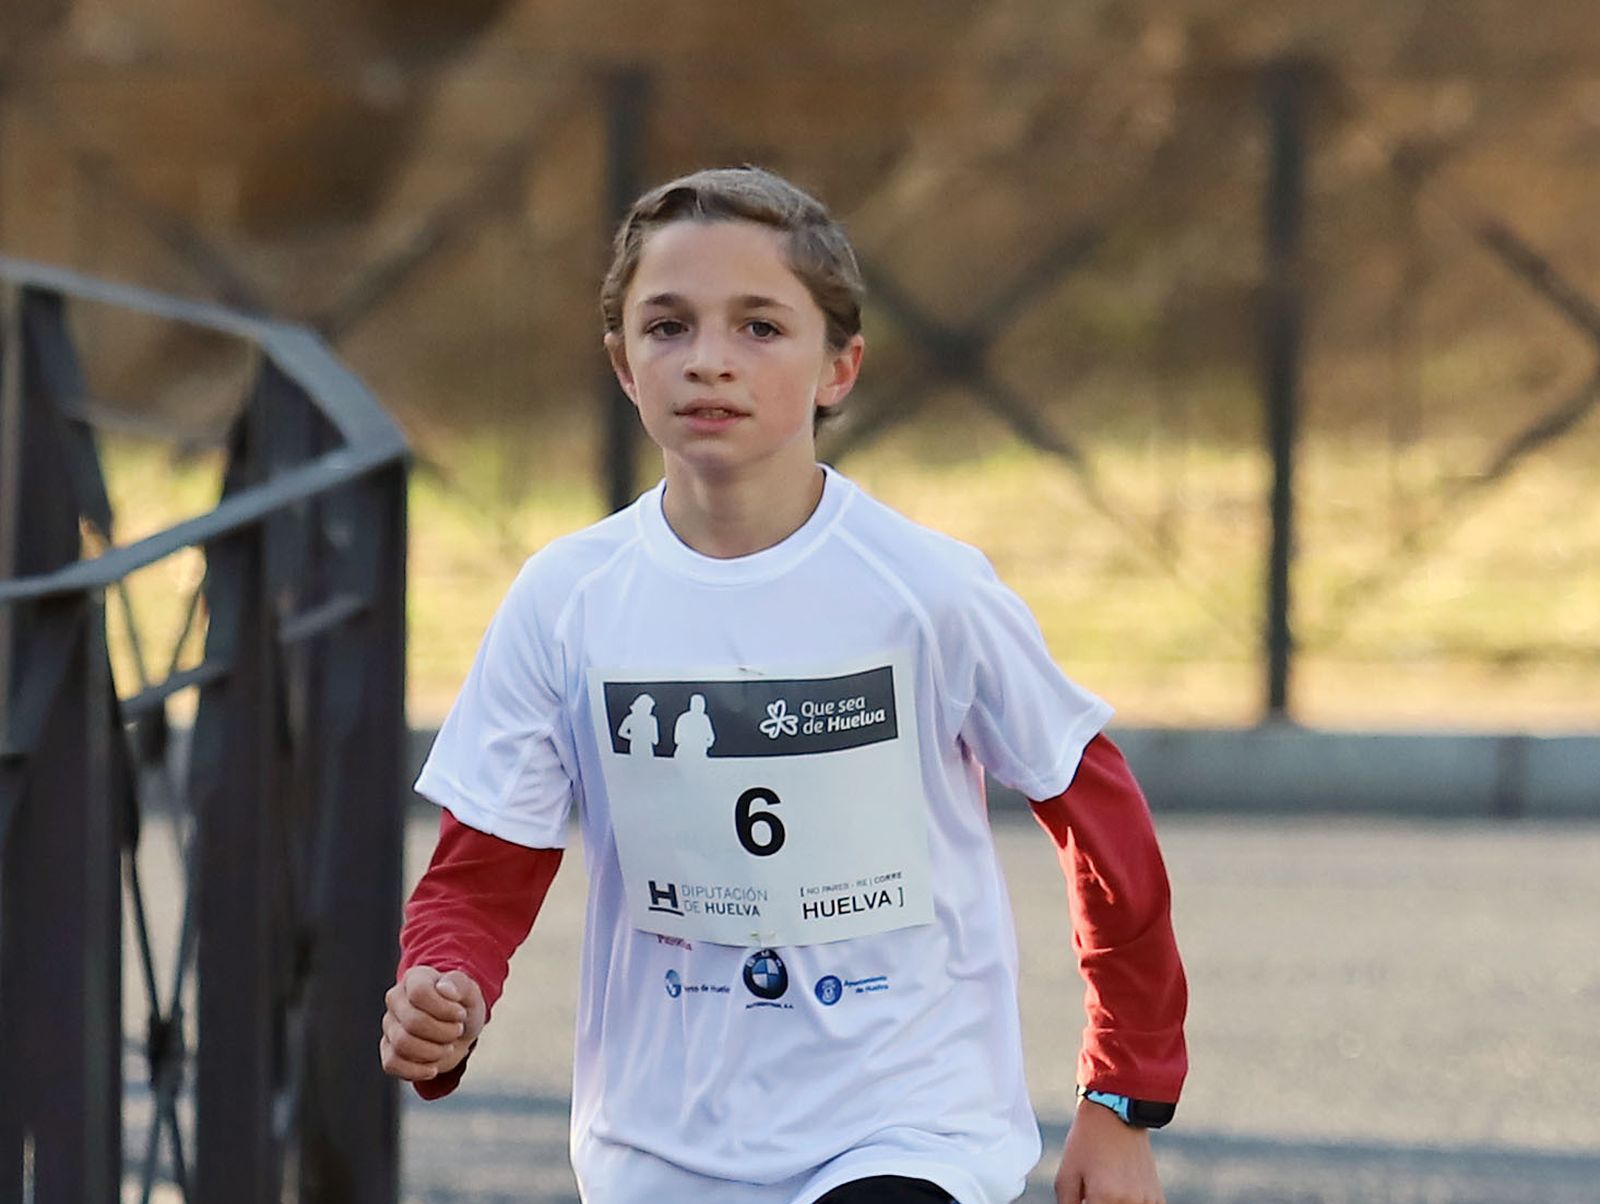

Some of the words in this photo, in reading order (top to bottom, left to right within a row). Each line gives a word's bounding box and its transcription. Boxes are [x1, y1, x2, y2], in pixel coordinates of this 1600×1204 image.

[801, 701, 835, 718] Que
[838, 696, 865, 713] sea
[803, 719, 824, 734] de
[827, 709, 886, 733] Huelva
[735, 787, 786, 857] 6
[681, 885, 768, 902] DIPUTACIÓN
[802, 890, 892, 920] HUELVA
[683, 900, 701, 913] DE
[704, 902, 761, 917] HUELVA
